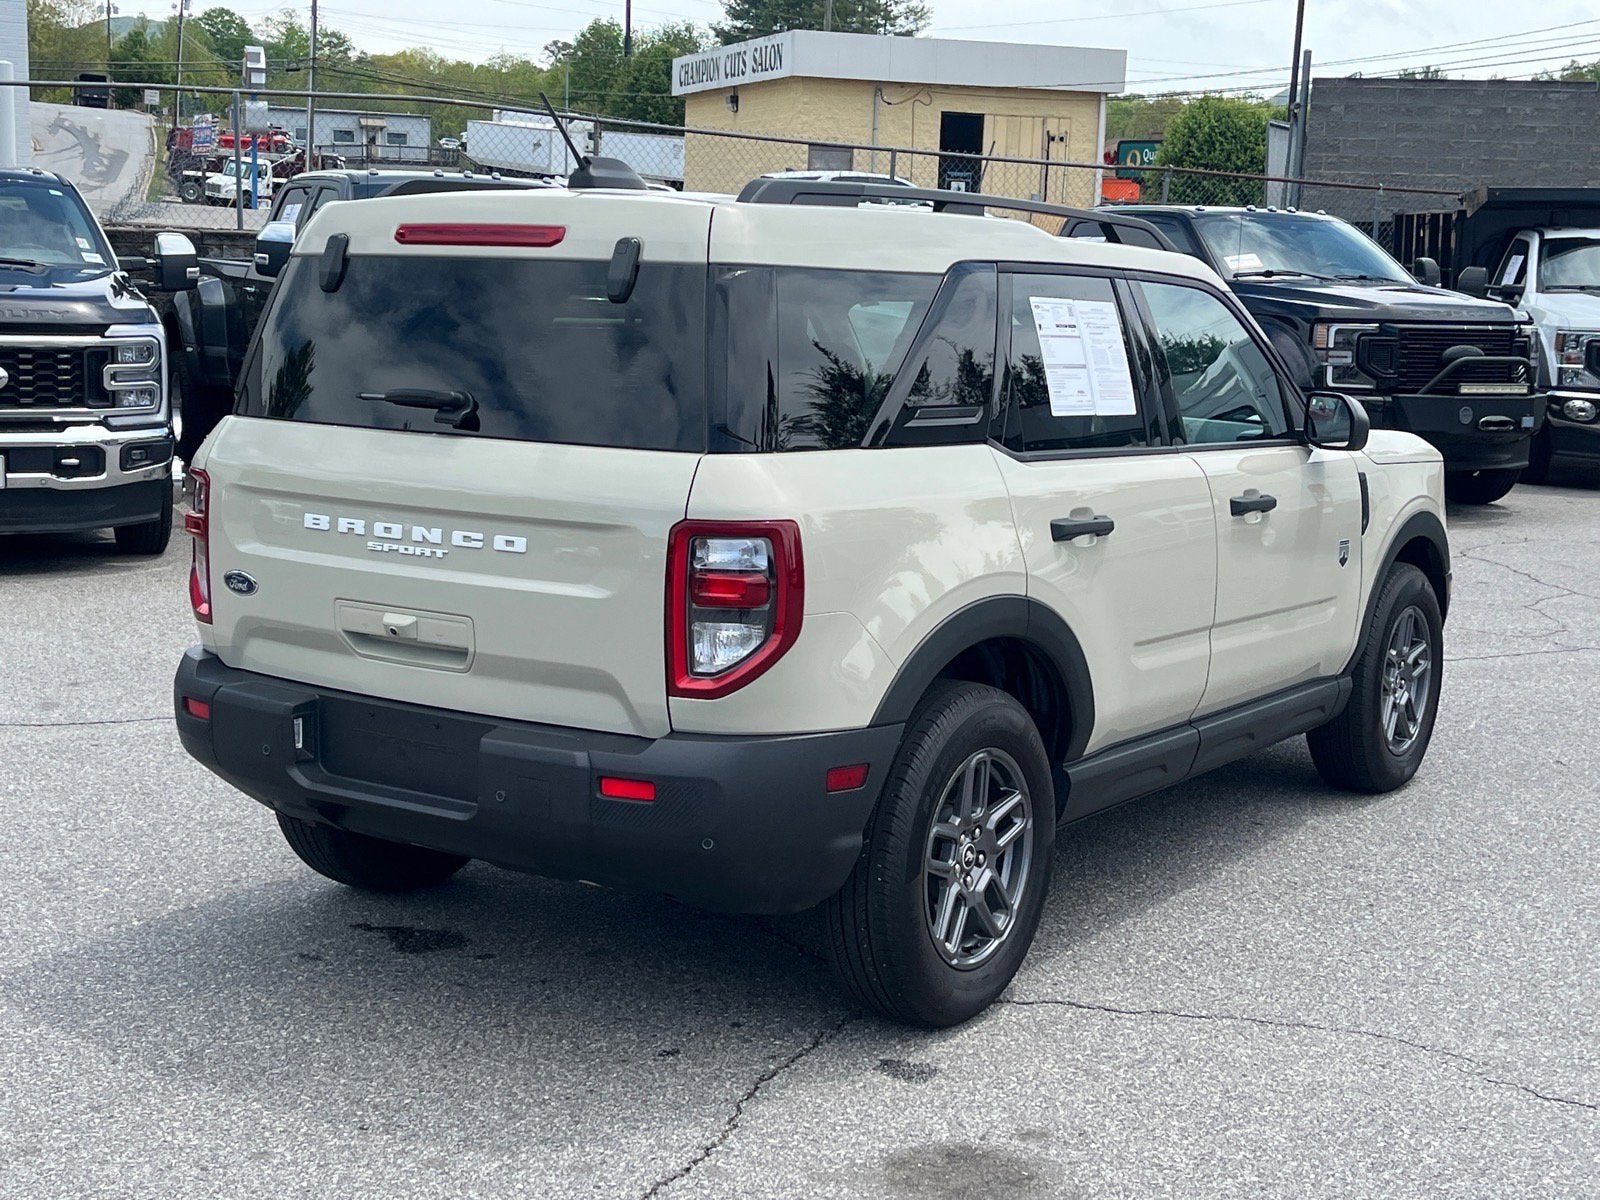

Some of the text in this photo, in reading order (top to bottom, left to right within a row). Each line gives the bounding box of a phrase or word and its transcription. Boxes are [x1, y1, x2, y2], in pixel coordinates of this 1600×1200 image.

[679, 43, 783, 87] CHAMPION CUTS SALON
[304, 513, 527, 553] BRONCO
[367, 541, 449, 559] SPORT
[228, 575, 249, 591] Ford
